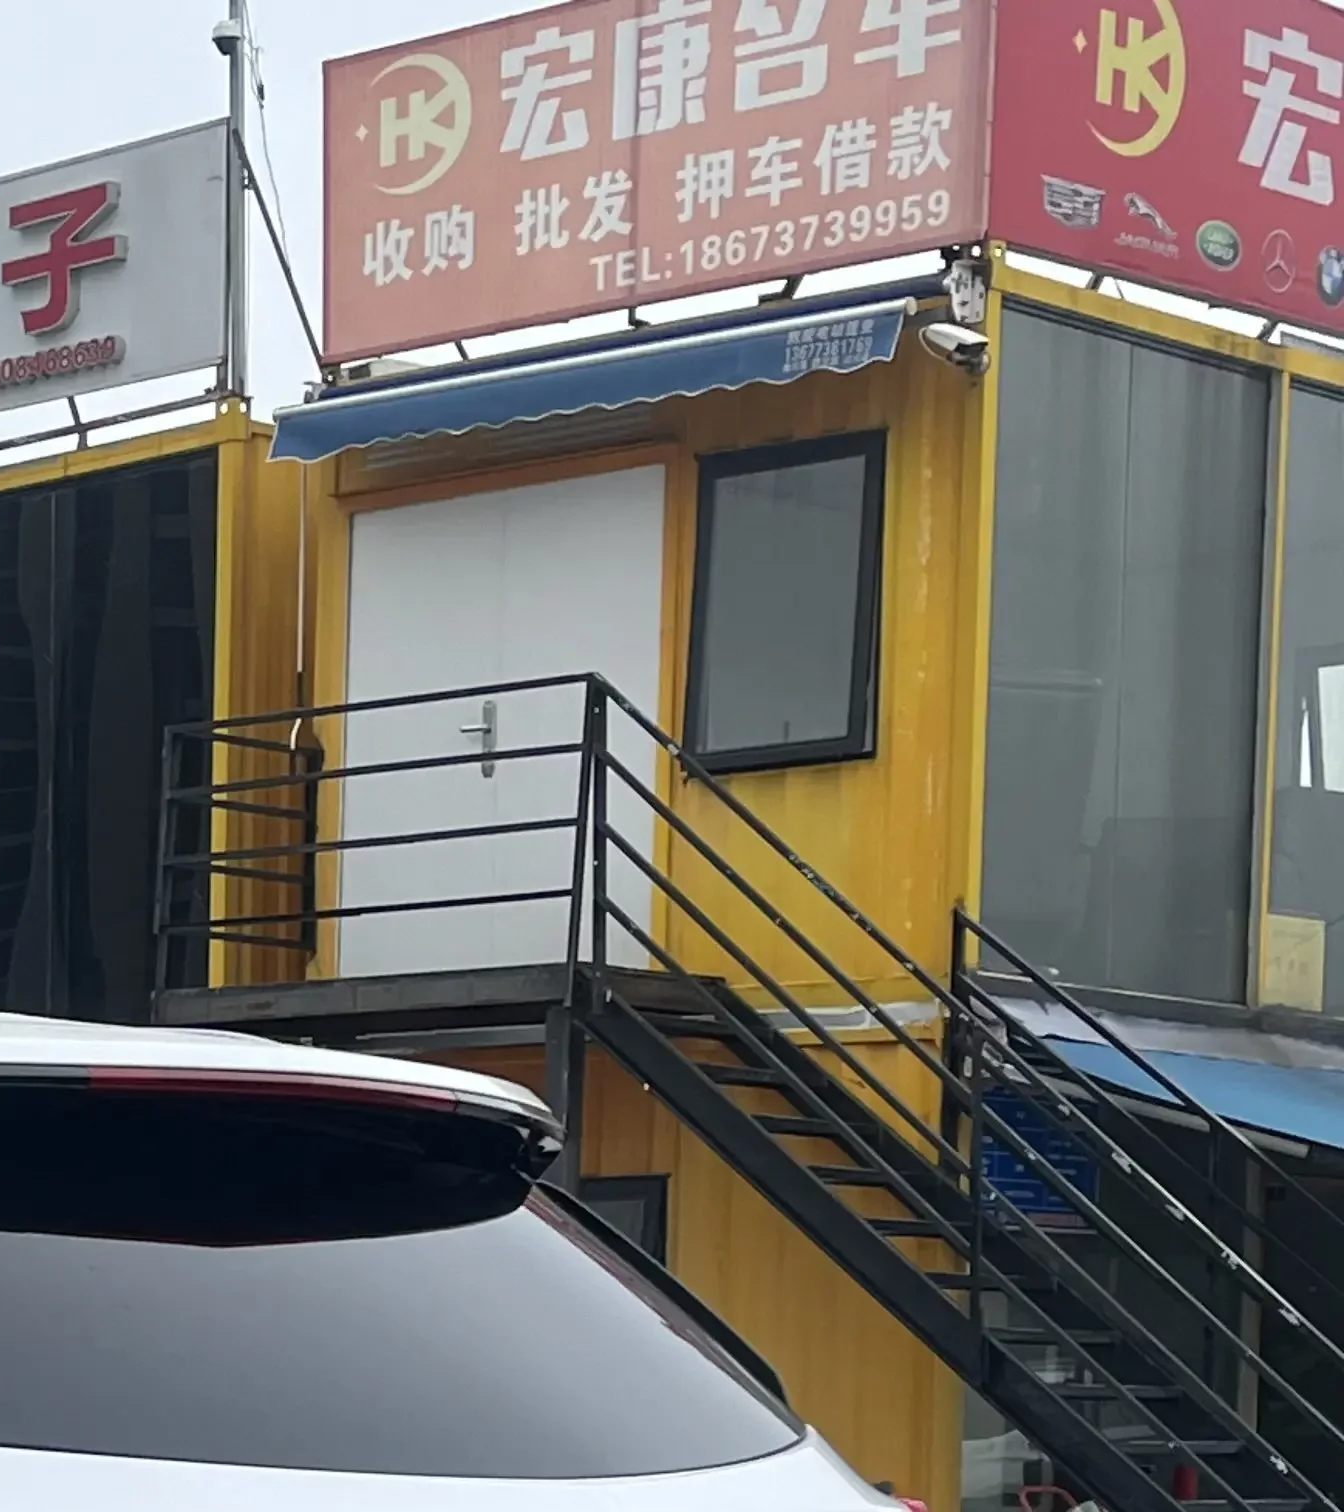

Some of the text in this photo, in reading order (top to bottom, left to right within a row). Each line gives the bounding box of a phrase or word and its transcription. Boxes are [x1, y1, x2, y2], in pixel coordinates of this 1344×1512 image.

[362, 102, 953, 287] 收购 批发 押车借款
[1237, 26, 1344, 206] 宏
[589, 189, 951, 293] TEL:18673739959
